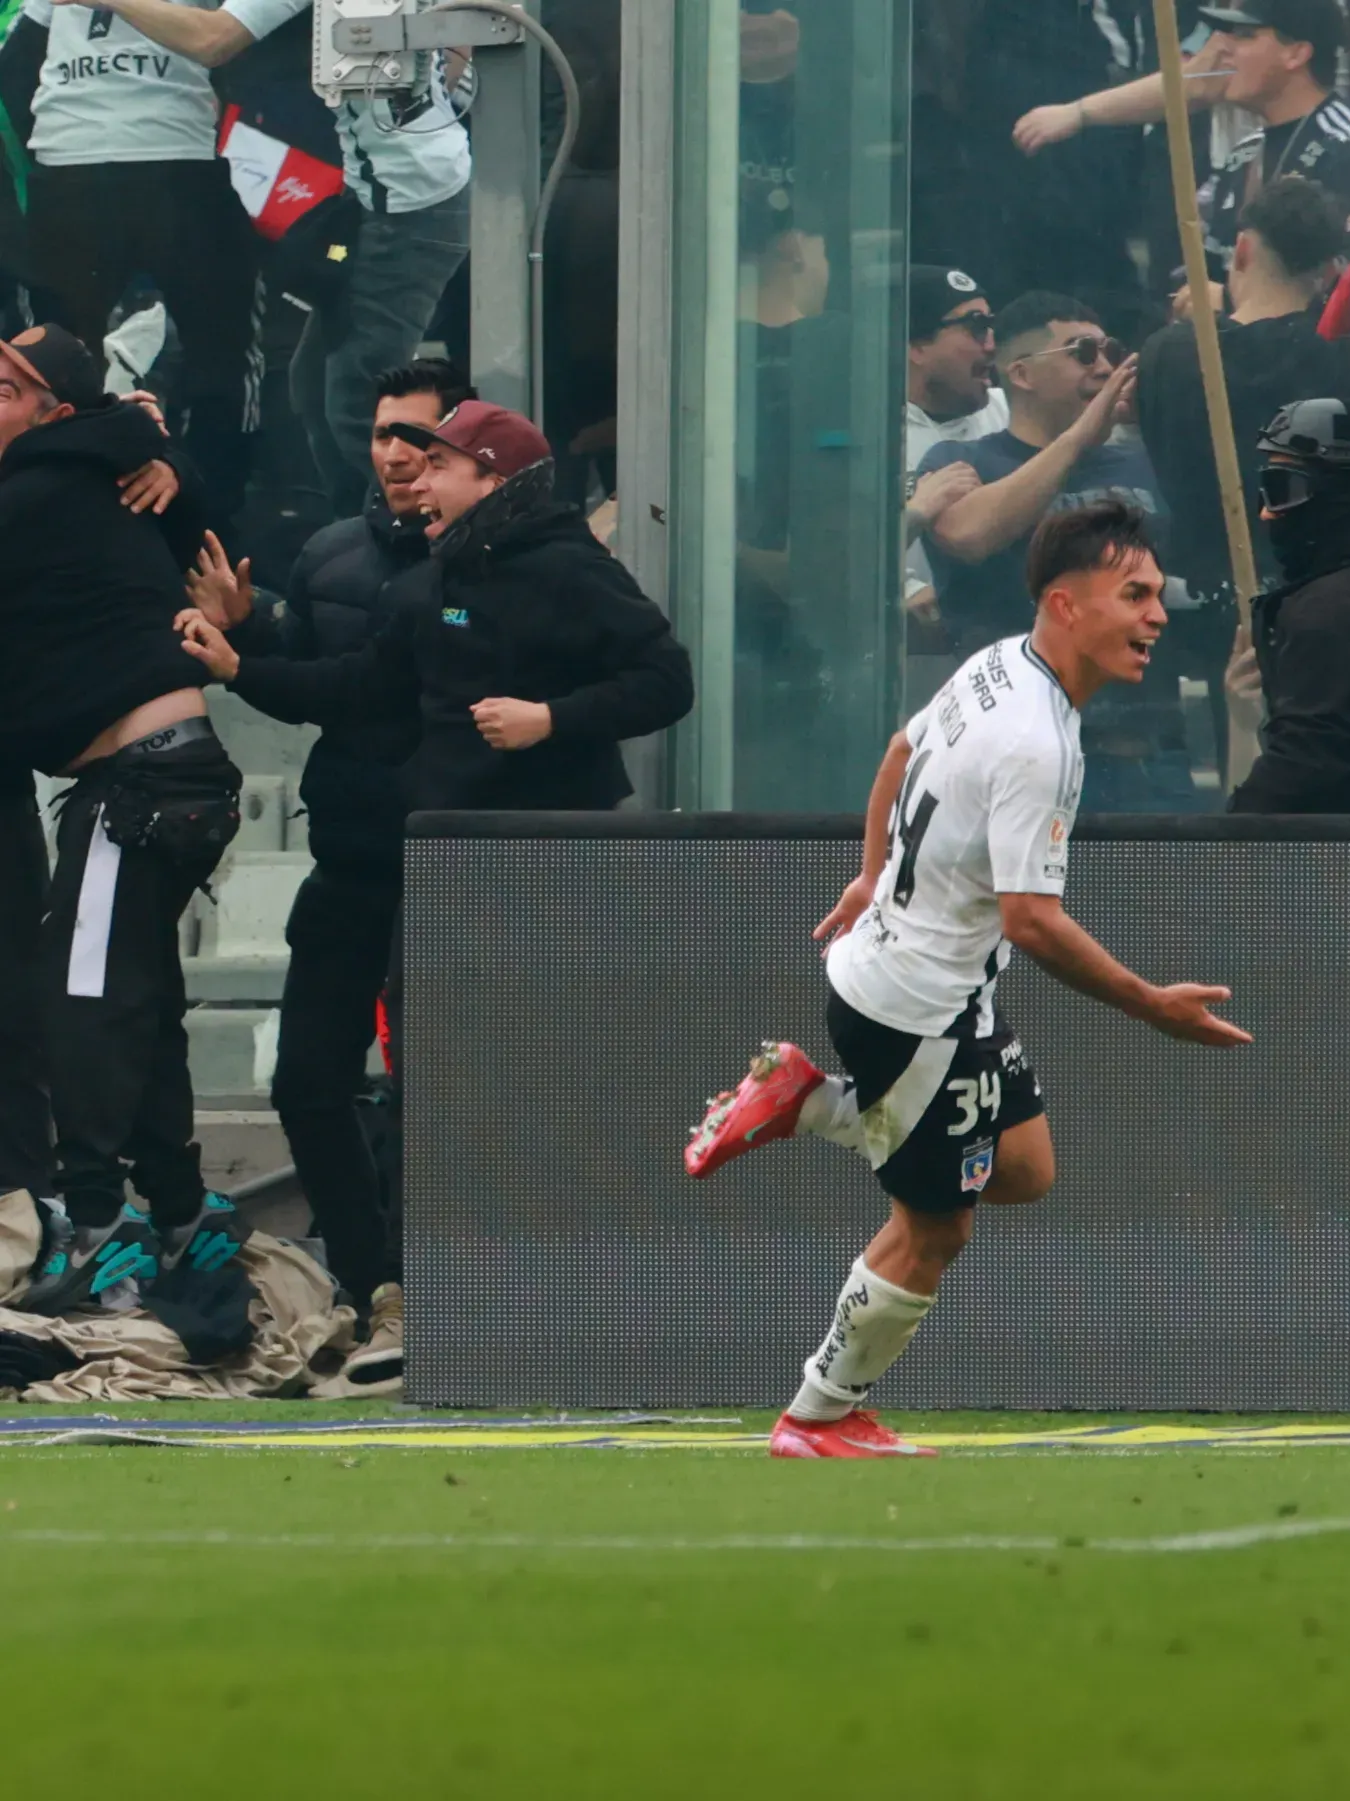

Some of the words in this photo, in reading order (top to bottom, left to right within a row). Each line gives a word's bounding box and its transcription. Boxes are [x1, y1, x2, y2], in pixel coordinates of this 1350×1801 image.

[57, 53, 171, 85] DIRECTV
[136, 728, 177, 753] TOP
[946, 1070, 1001, 1136] 34
